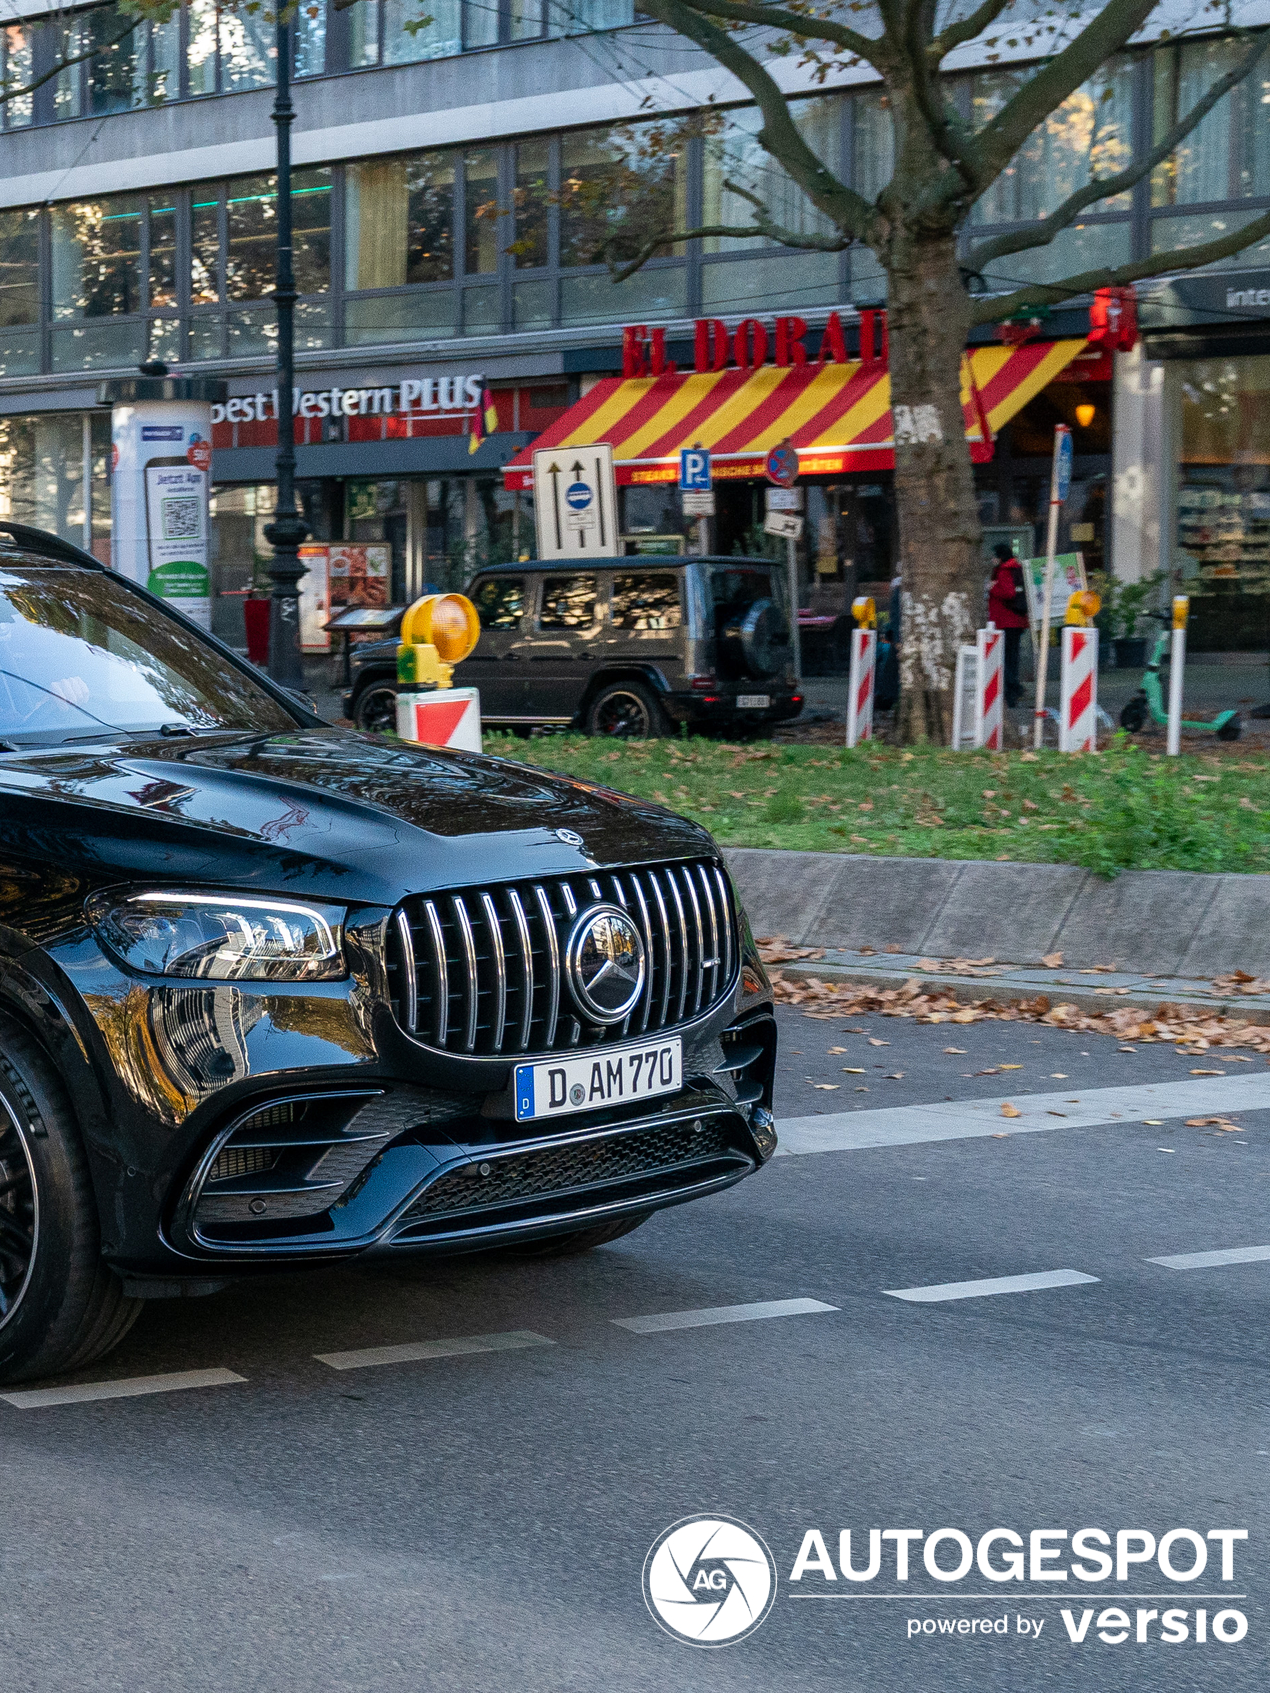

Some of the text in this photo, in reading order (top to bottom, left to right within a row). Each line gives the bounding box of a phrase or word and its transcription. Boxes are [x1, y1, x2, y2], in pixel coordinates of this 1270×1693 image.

[694, 310, 889, 373] DORAD
[400, 375, 482, 412] PLUS
[686, 454, 705, 485] P
[548, 1068, 567, 1108] D
